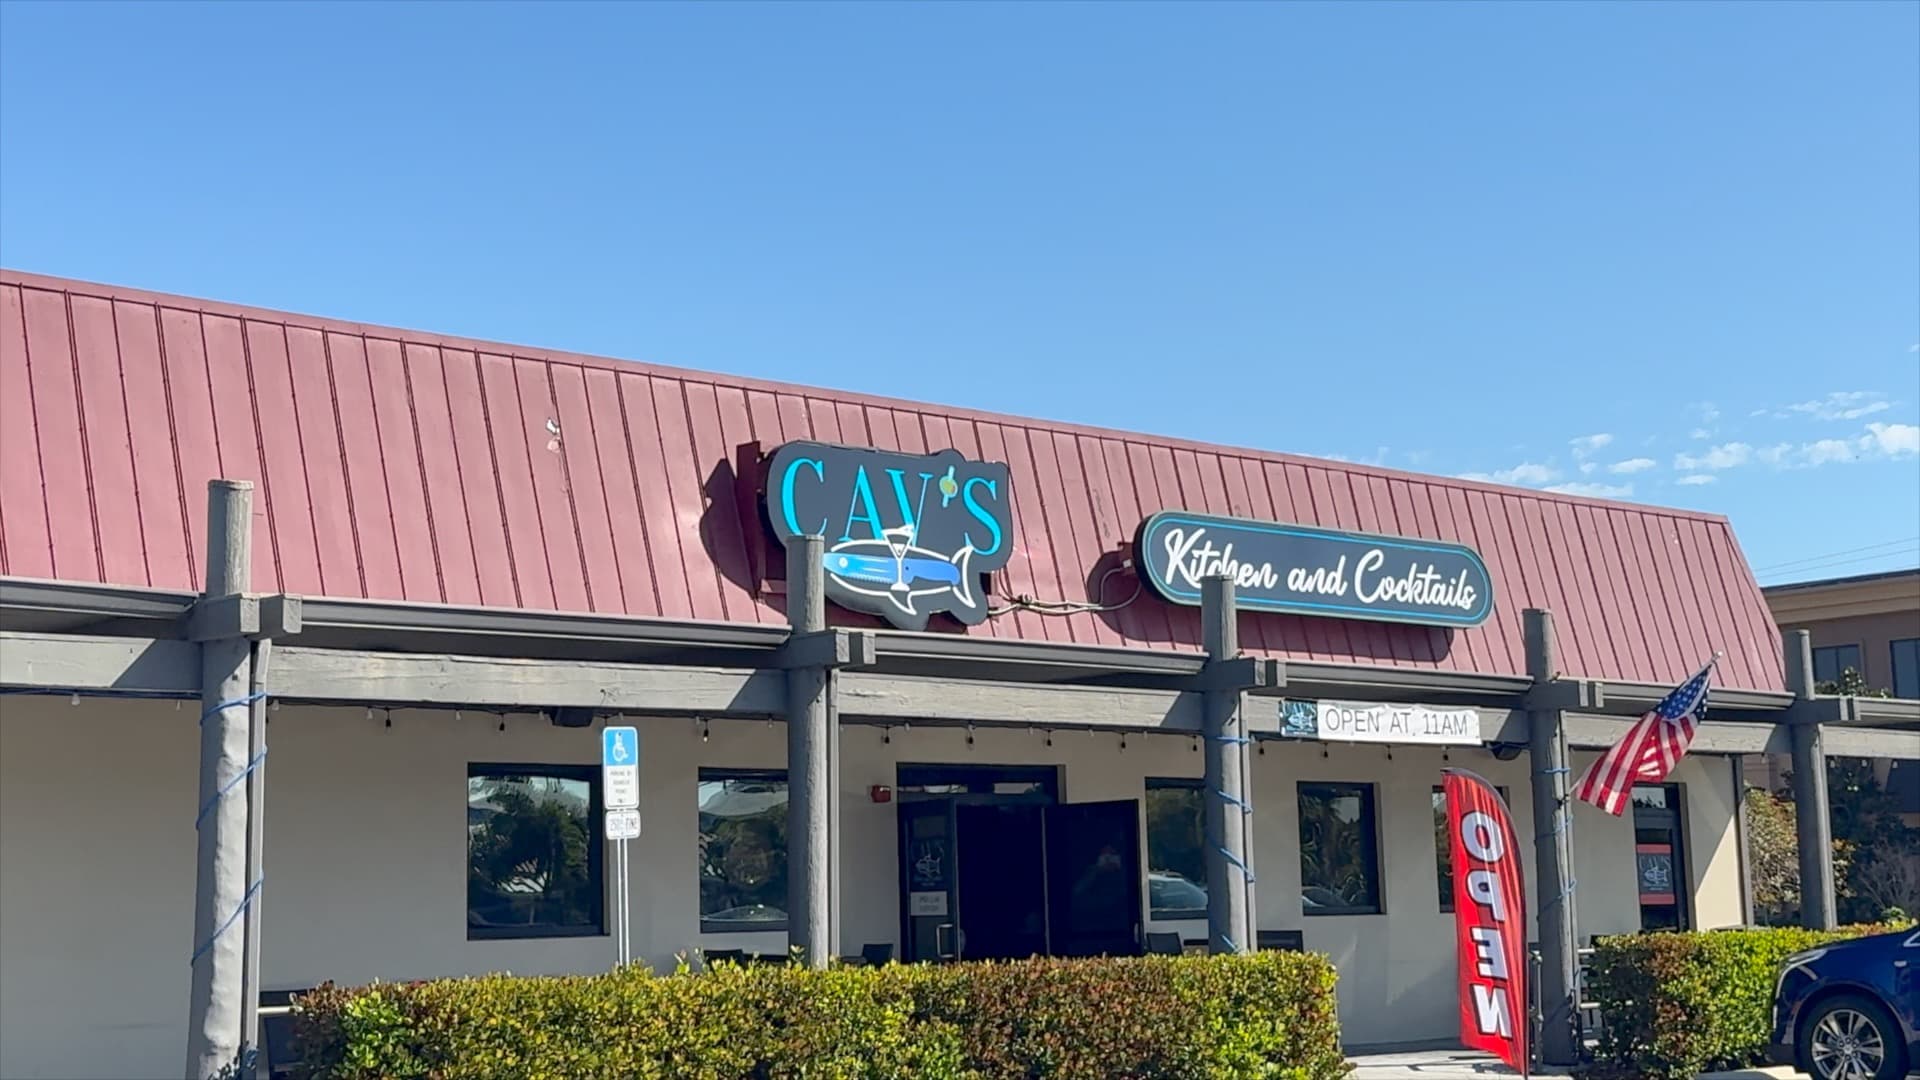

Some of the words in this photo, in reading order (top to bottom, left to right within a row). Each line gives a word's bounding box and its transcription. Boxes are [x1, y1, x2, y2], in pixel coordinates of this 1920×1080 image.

[781, 457, 1002, 556] CAV'S
[1164, 528, 1278, 589] Kitchen
[1287, 555, 1347, 596] and
[1354, 549, 1477, 610] Cocktails
[1325, 708, 1380, 733] OPEN
[1423, 713, 1468, 735] 11AM
